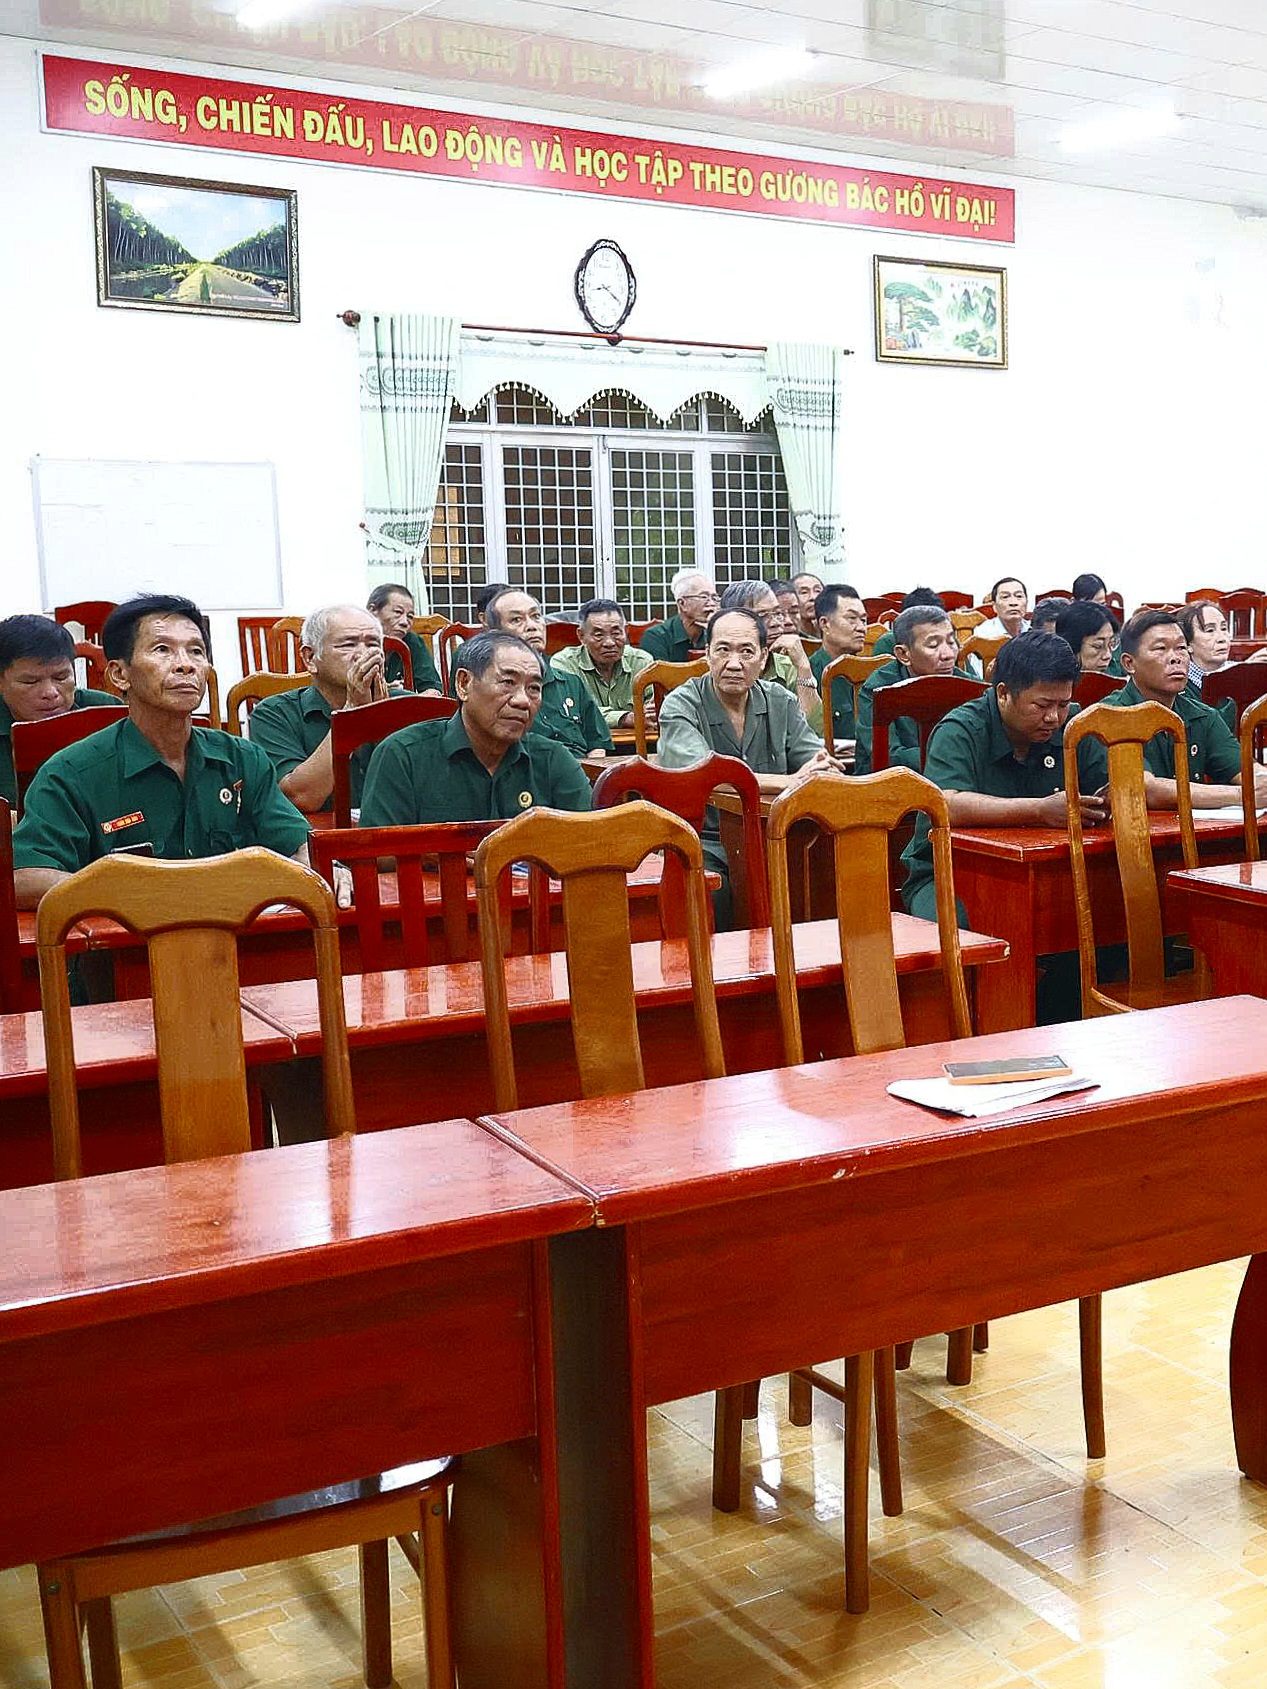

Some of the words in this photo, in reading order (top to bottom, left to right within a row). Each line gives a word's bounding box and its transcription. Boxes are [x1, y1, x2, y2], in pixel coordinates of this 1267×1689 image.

[83, 73, 188, 134] SỐNG,
[195, 92, 296, 141] CHIẾN
[302, 103, 374, 156] ĐẤU,
[381, 119, 438, 159] LAO
[444, 125, 523, 172] ĐỘNG
[530, 134, 567, 173] VÀ
[574, 145, 629, 187] HỌC
[633, 150, 684, 194] TẬP
[689, 160, 754, 197] THEO
[759, 167, 840, 208] GƯƠNG
[846, 176, 890, 213] BÁC
[894, 182, 925, 218] HỒ
[930, 187, 952, 222] VĨ
[955, 195, 998, 232] ĐẠI!
